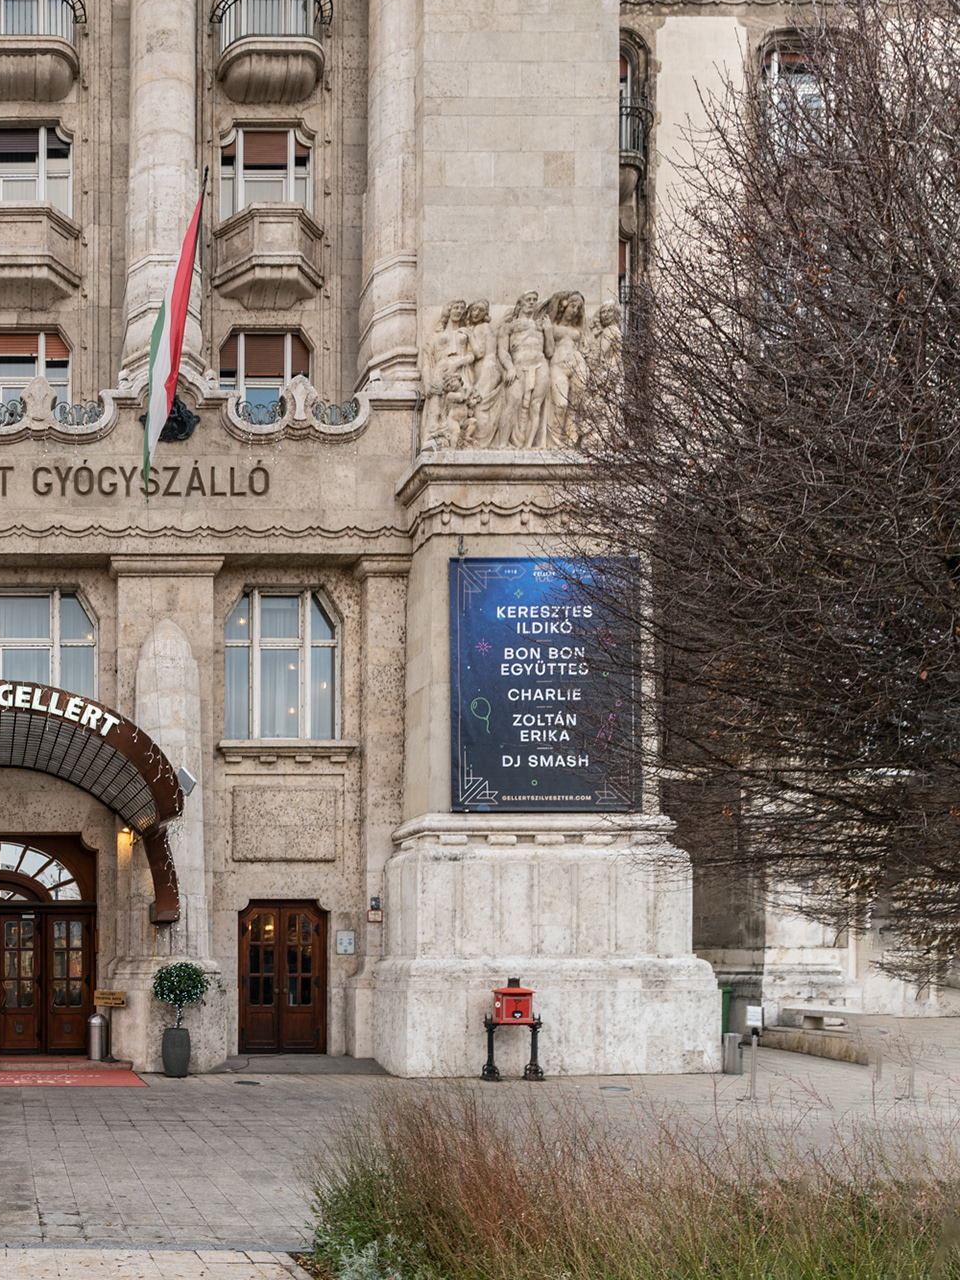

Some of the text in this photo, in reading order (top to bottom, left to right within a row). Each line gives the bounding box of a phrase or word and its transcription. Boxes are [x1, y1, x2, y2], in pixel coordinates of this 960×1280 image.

[31, 458, 271, 498] GYÓGYSZÁLLÓ
[496, 605, 594, 618] KERESZTES
[516, 619, 573, 634] ILDIKÓ
[503, 646, 585, 660] BON BON
[500, 660, 589, 676] EGYÜTTES
[507, 688, 582, 701] CHARLIE
[512, 710, 577, 726] ZOLTÁN
[520, 729, 570, 742] ERIKA
[502, 754, 589, 767] DJ SMASH
